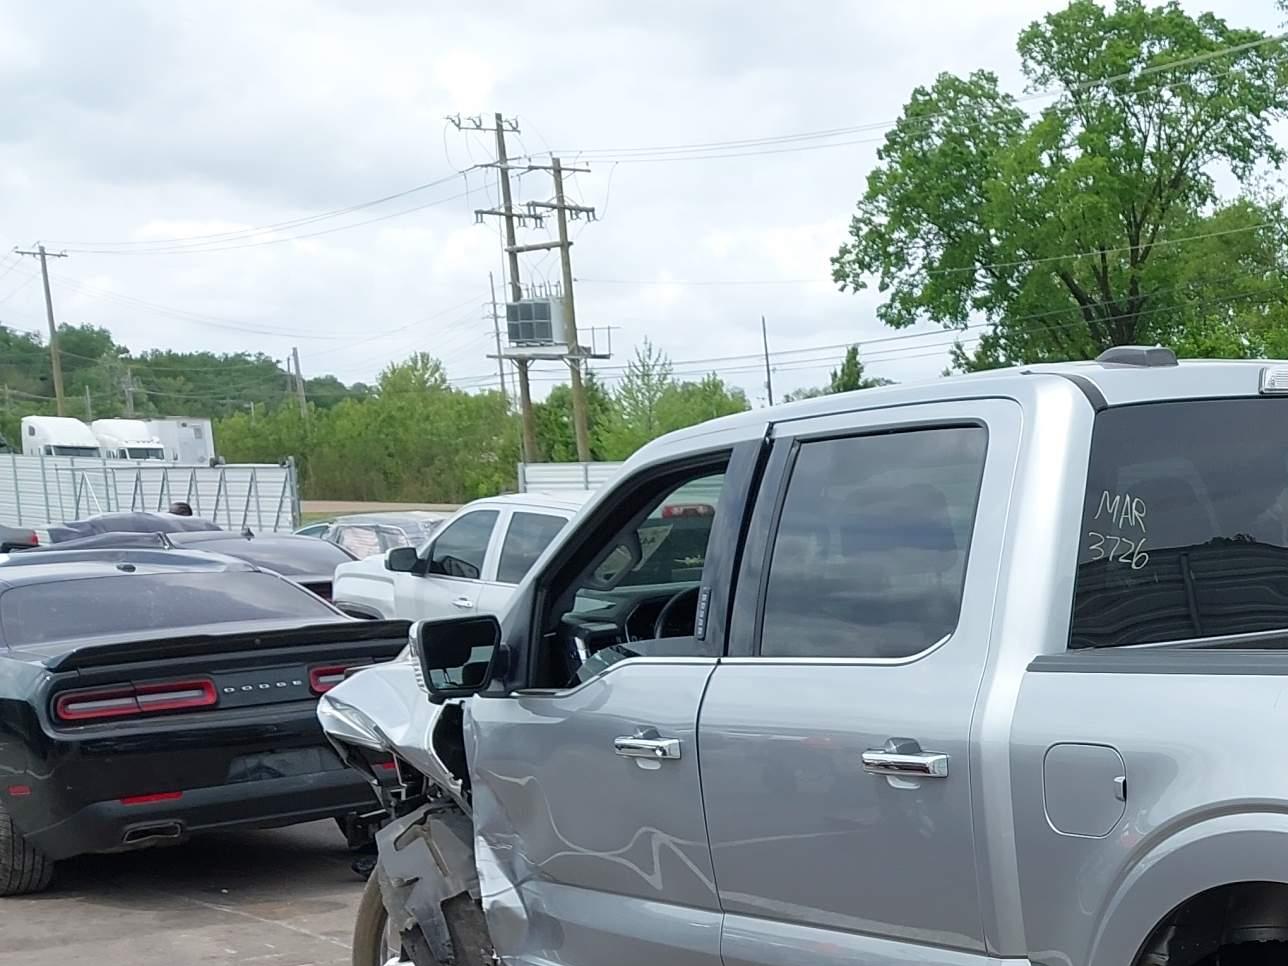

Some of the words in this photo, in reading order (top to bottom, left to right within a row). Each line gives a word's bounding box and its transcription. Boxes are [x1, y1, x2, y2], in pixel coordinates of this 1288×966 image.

[1093, 490, 1147, 533] MAR
[1088, 531, 1150, 570] 3726
[223, 679, 303, 693] DODGE
